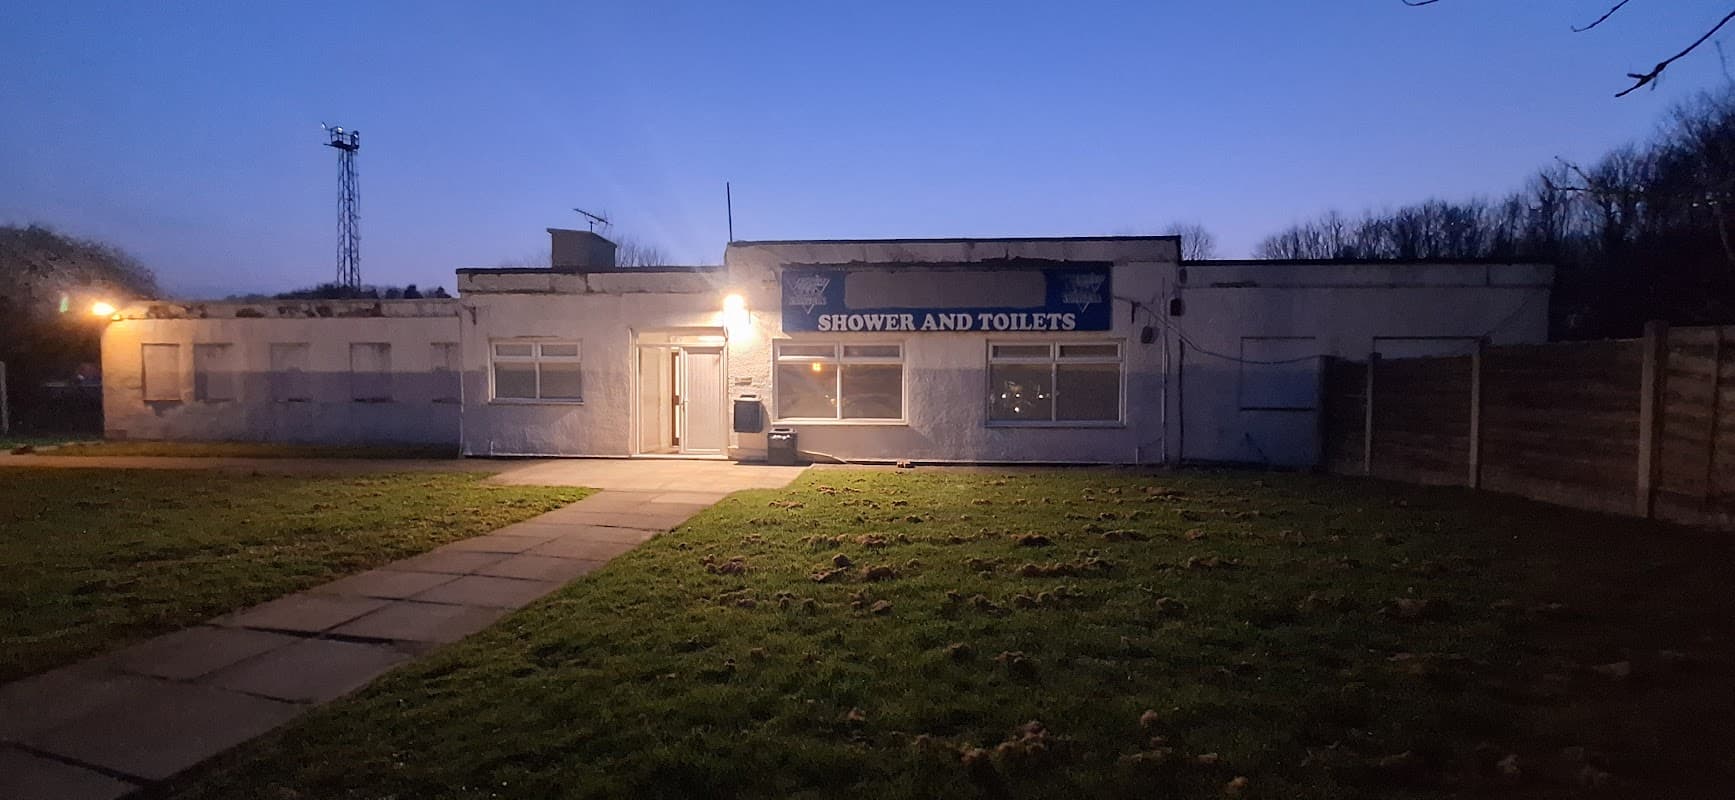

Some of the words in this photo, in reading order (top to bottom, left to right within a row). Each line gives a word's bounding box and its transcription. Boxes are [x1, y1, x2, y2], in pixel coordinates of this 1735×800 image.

[818, 314, 916, 331] SHOWER
[920, 313, 973, 331] AND
[978, 313, 1076, 331] TOILETS
